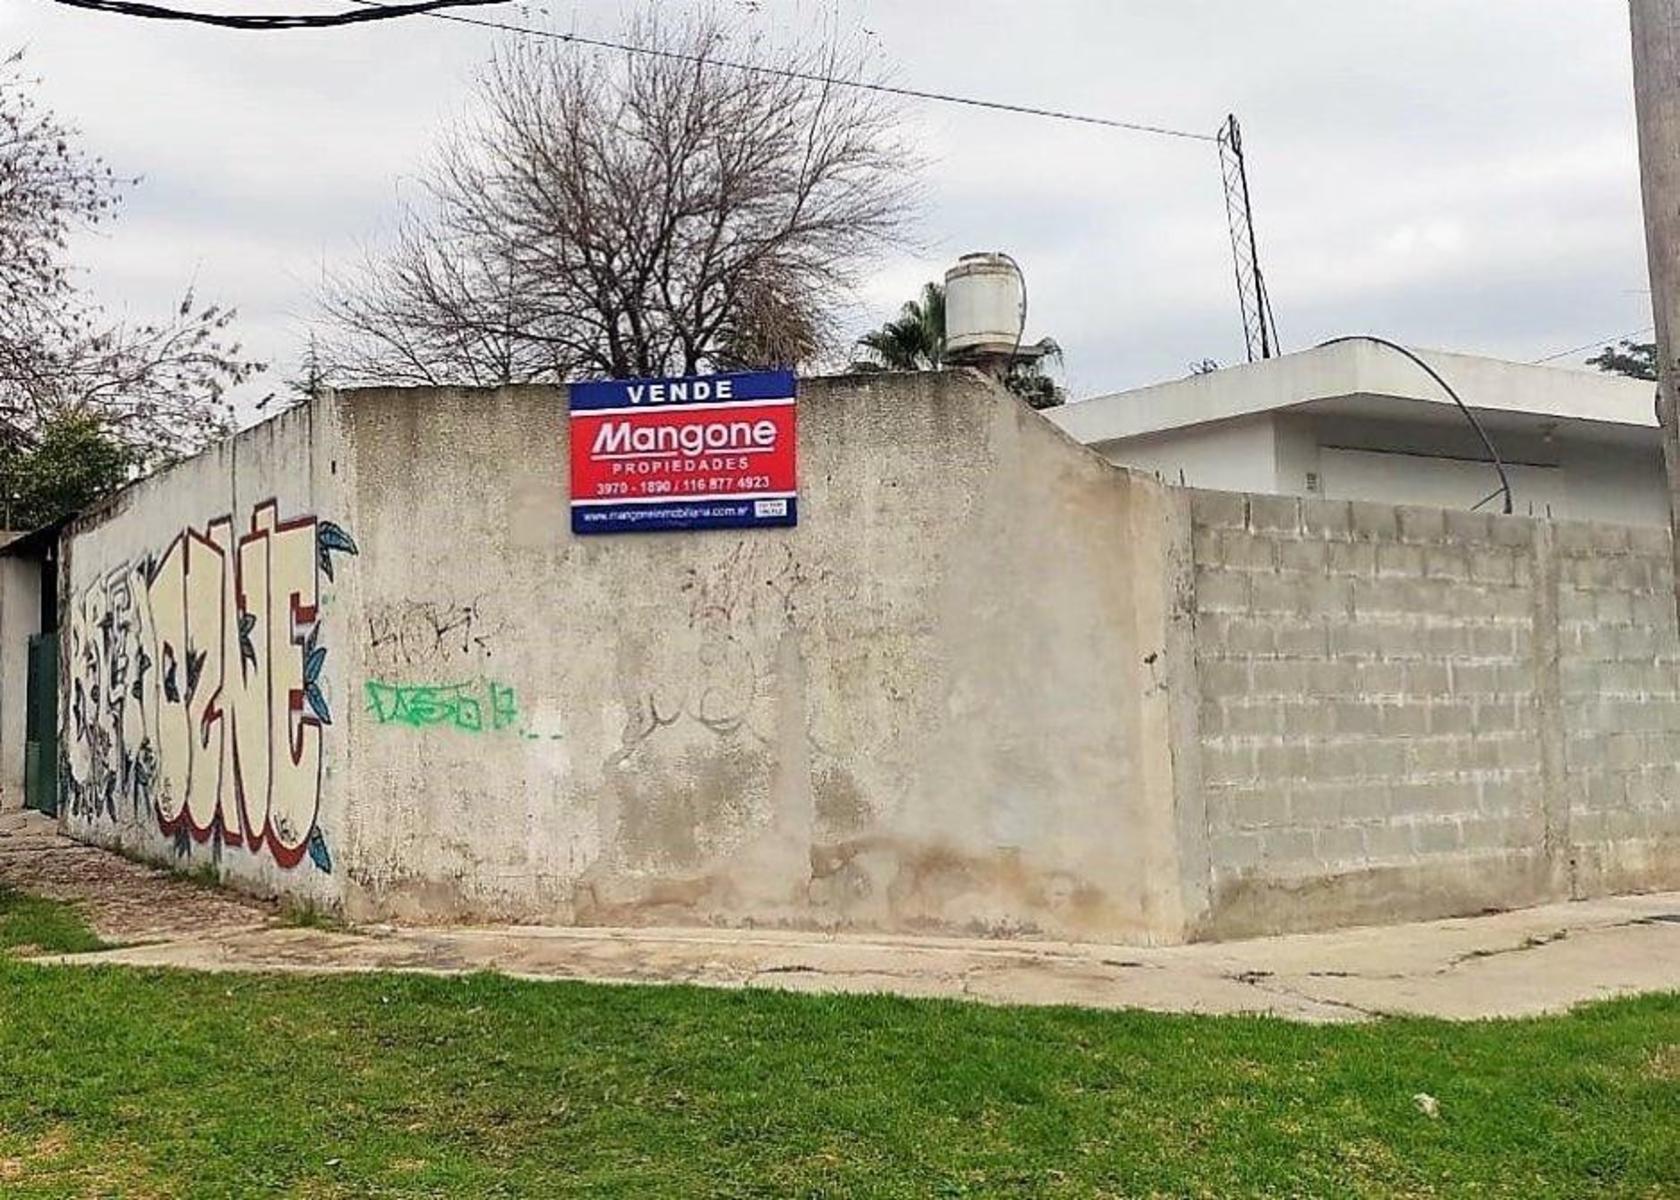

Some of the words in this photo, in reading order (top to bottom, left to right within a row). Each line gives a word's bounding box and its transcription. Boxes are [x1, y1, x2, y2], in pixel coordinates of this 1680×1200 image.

[627, 381, 733, 403] VENDE
[591, 420, 777, 456] Mangone
[612, 457, 749, 475] PROPIEDADES
[597, 482, 628, 495] 3970
[683, 478, 705, 491] 116
[737, 475, 770, 488] 4923
